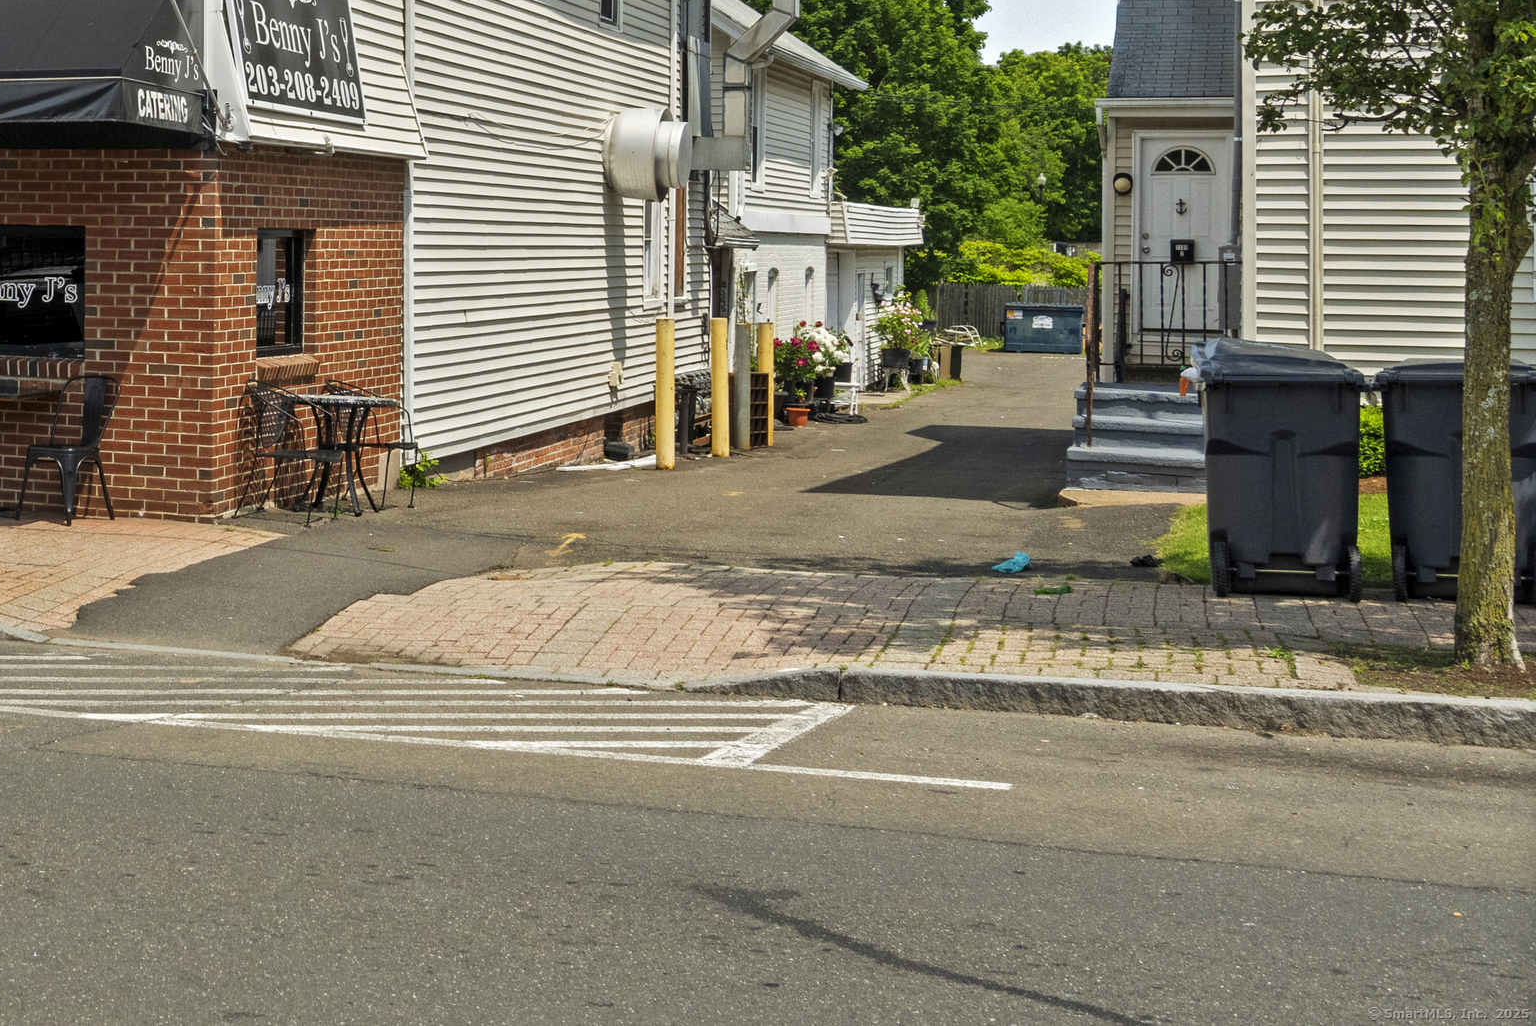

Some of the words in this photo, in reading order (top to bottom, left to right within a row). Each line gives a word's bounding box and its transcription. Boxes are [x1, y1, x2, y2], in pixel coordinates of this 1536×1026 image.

[249, 0, 312, 68] Benny
[316, 17, 342, 63] J's
[144, 45, 182, 83] Benny
[184, 55, 199, 81] J's
[244, 60, 360, 110] 203-208-2409
[137, 88, 189, 124] CATERING
[41, 276, 78, 303] J's
[276, 277, 291, 303] J's
